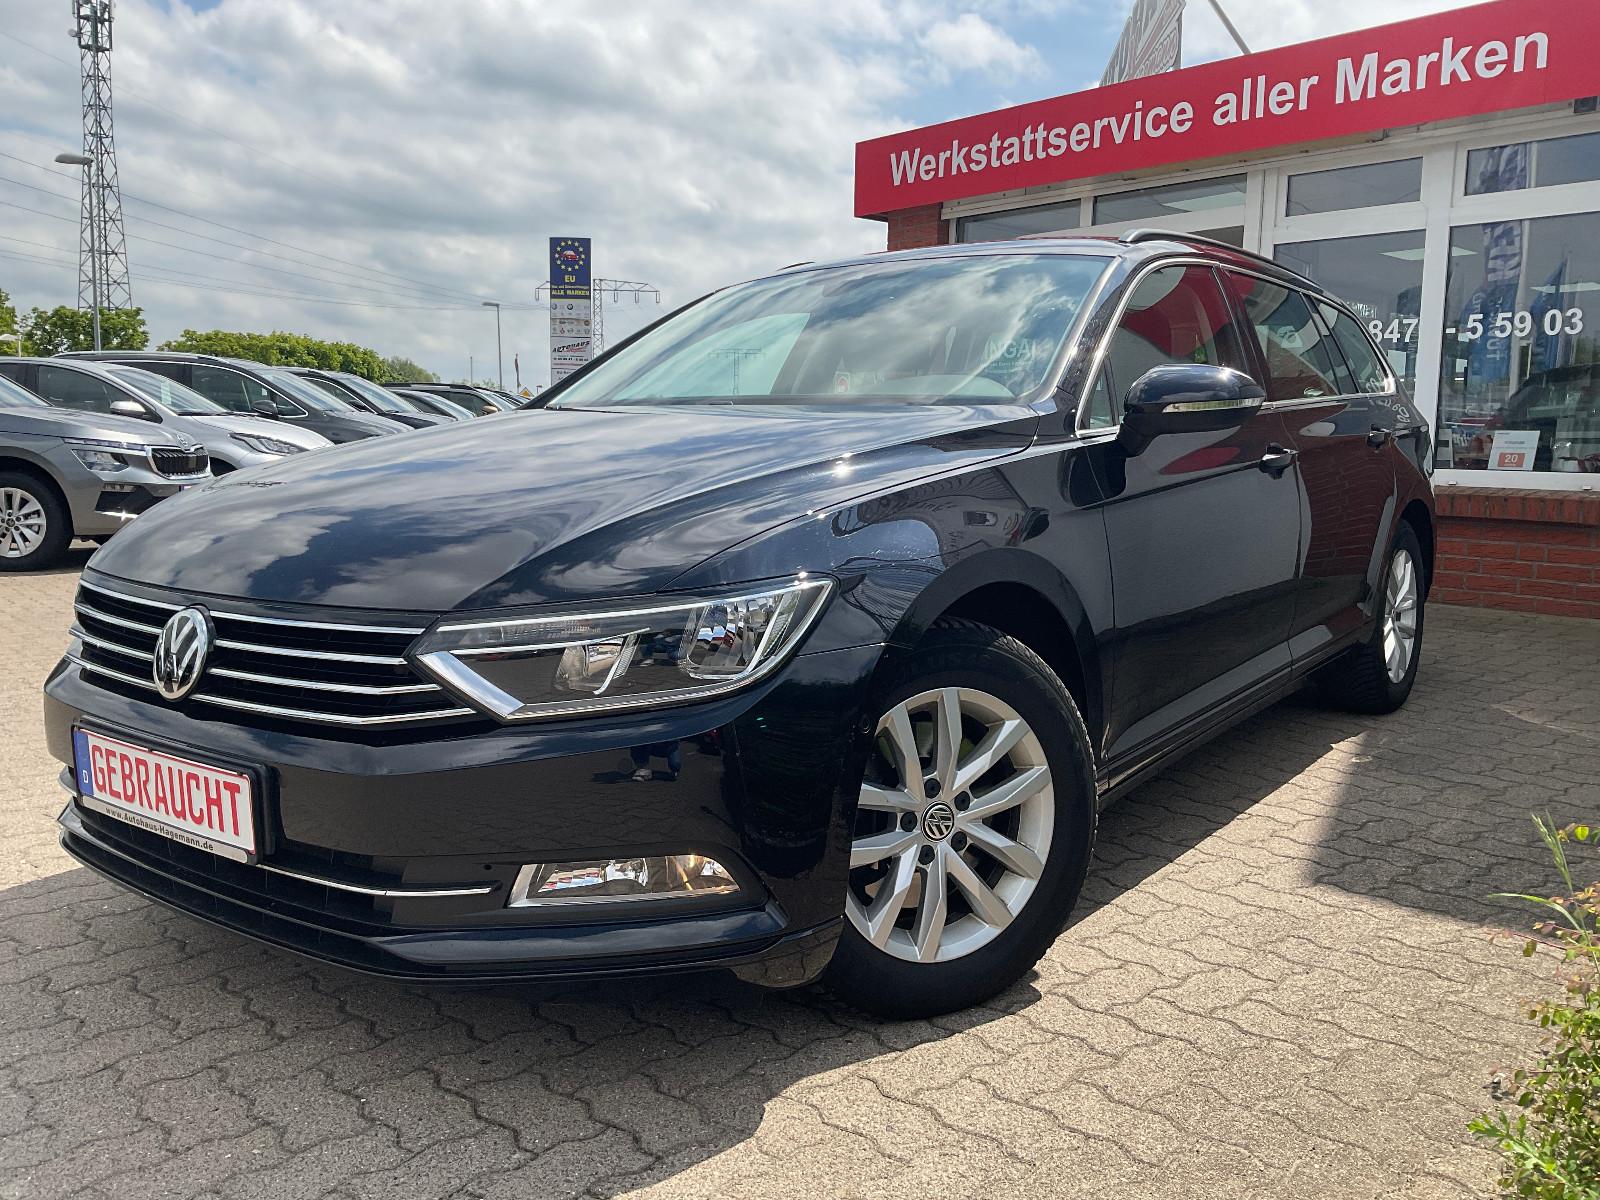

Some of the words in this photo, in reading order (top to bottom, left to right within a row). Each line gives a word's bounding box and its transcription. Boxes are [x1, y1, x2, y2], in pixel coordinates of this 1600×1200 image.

[890, 100, 1194, 186] Werkstattservice
[1212, 74, 1319, 126] aller
[1335, 31, 1549, 105] Marken
[564, 275, 576, 283] EU
[1466, 313, 1484, 339] 5
[1494, 311, 1532, 338] 59
[1543, 308, 1584, 335] 03
[1504, 453, 1519, 463] 20
[83, 769, 89, 784] D
[91, 744, 241, 837] GEBRAUCHT
[105, 806, 214, 852] www.Autohaus-Hagemann.de
